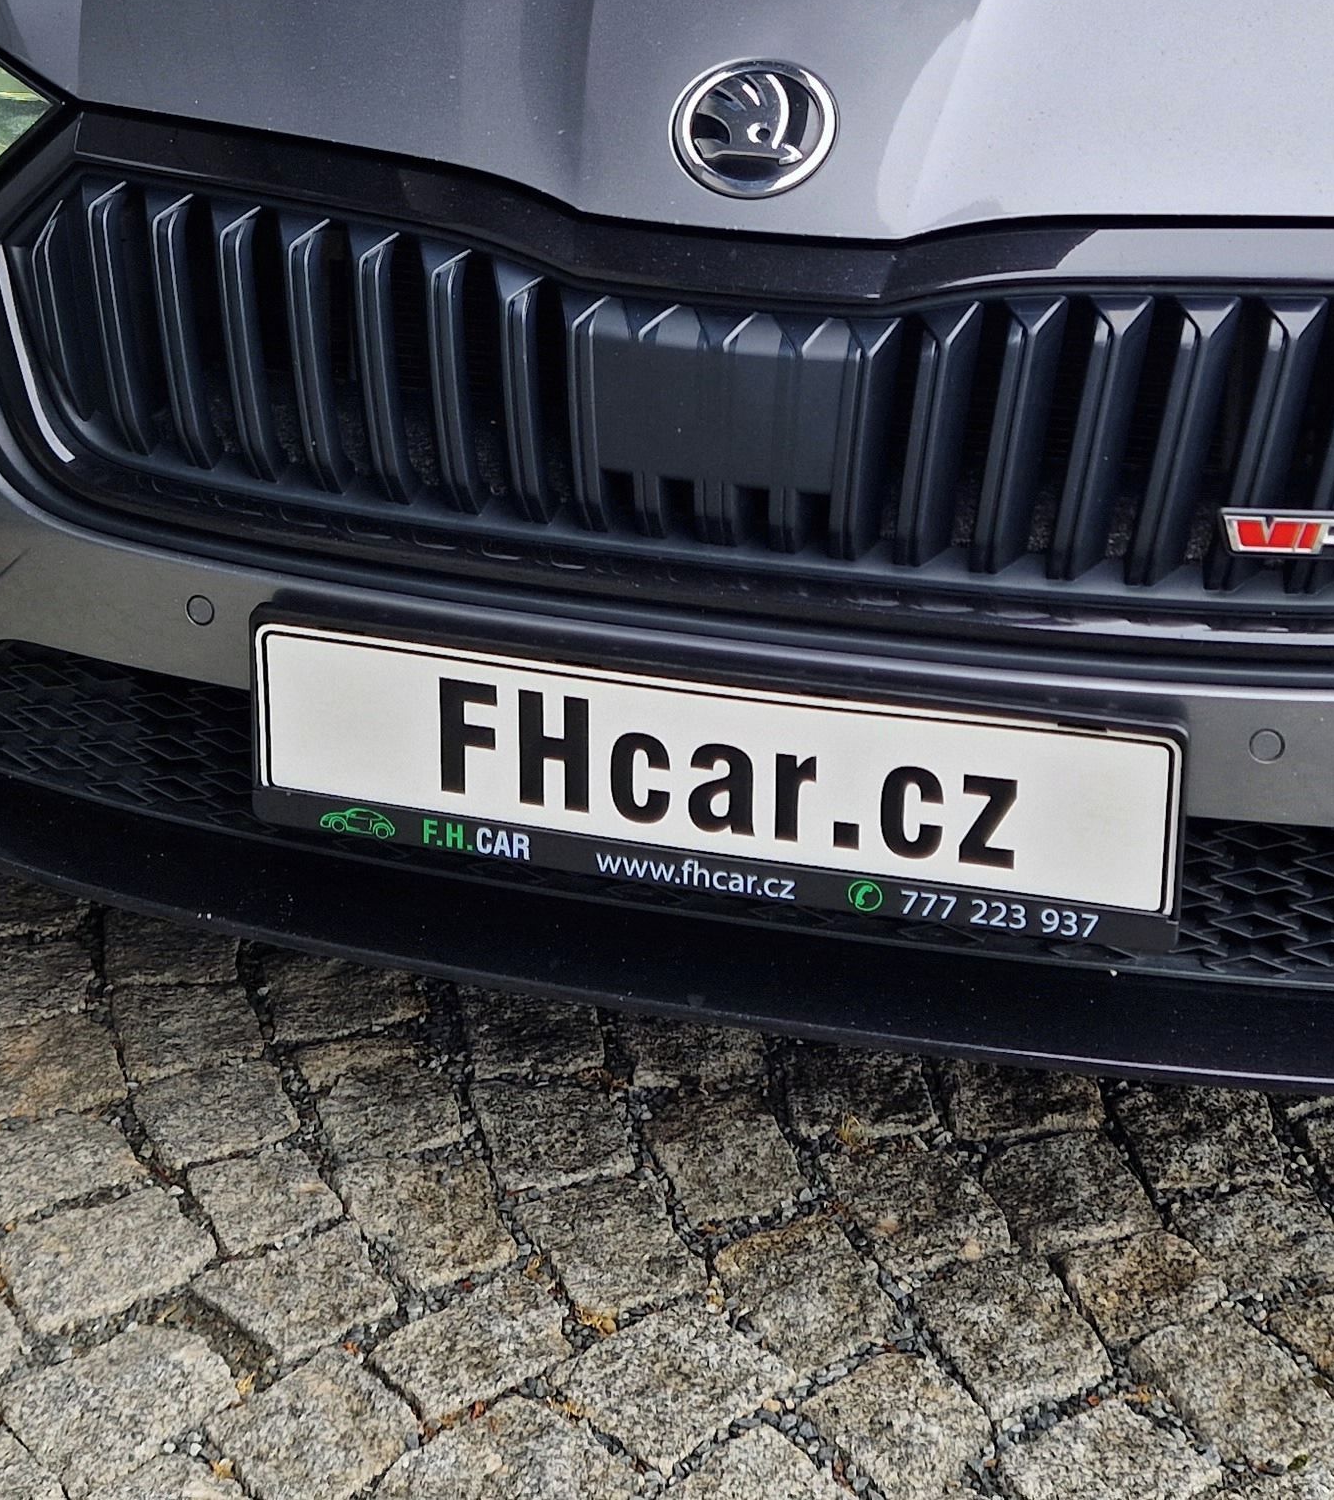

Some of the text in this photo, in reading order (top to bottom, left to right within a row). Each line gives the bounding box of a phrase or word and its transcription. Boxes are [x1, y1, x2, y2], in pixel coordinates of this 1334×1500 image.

[436, 677, 1020, 870] FHcar.cz
[422, 818, 531, 861] F.H.CAR
[596, 852, 796, 900] www.fhcar.cz
[900, 889, 1099, 938] 777 223 937
